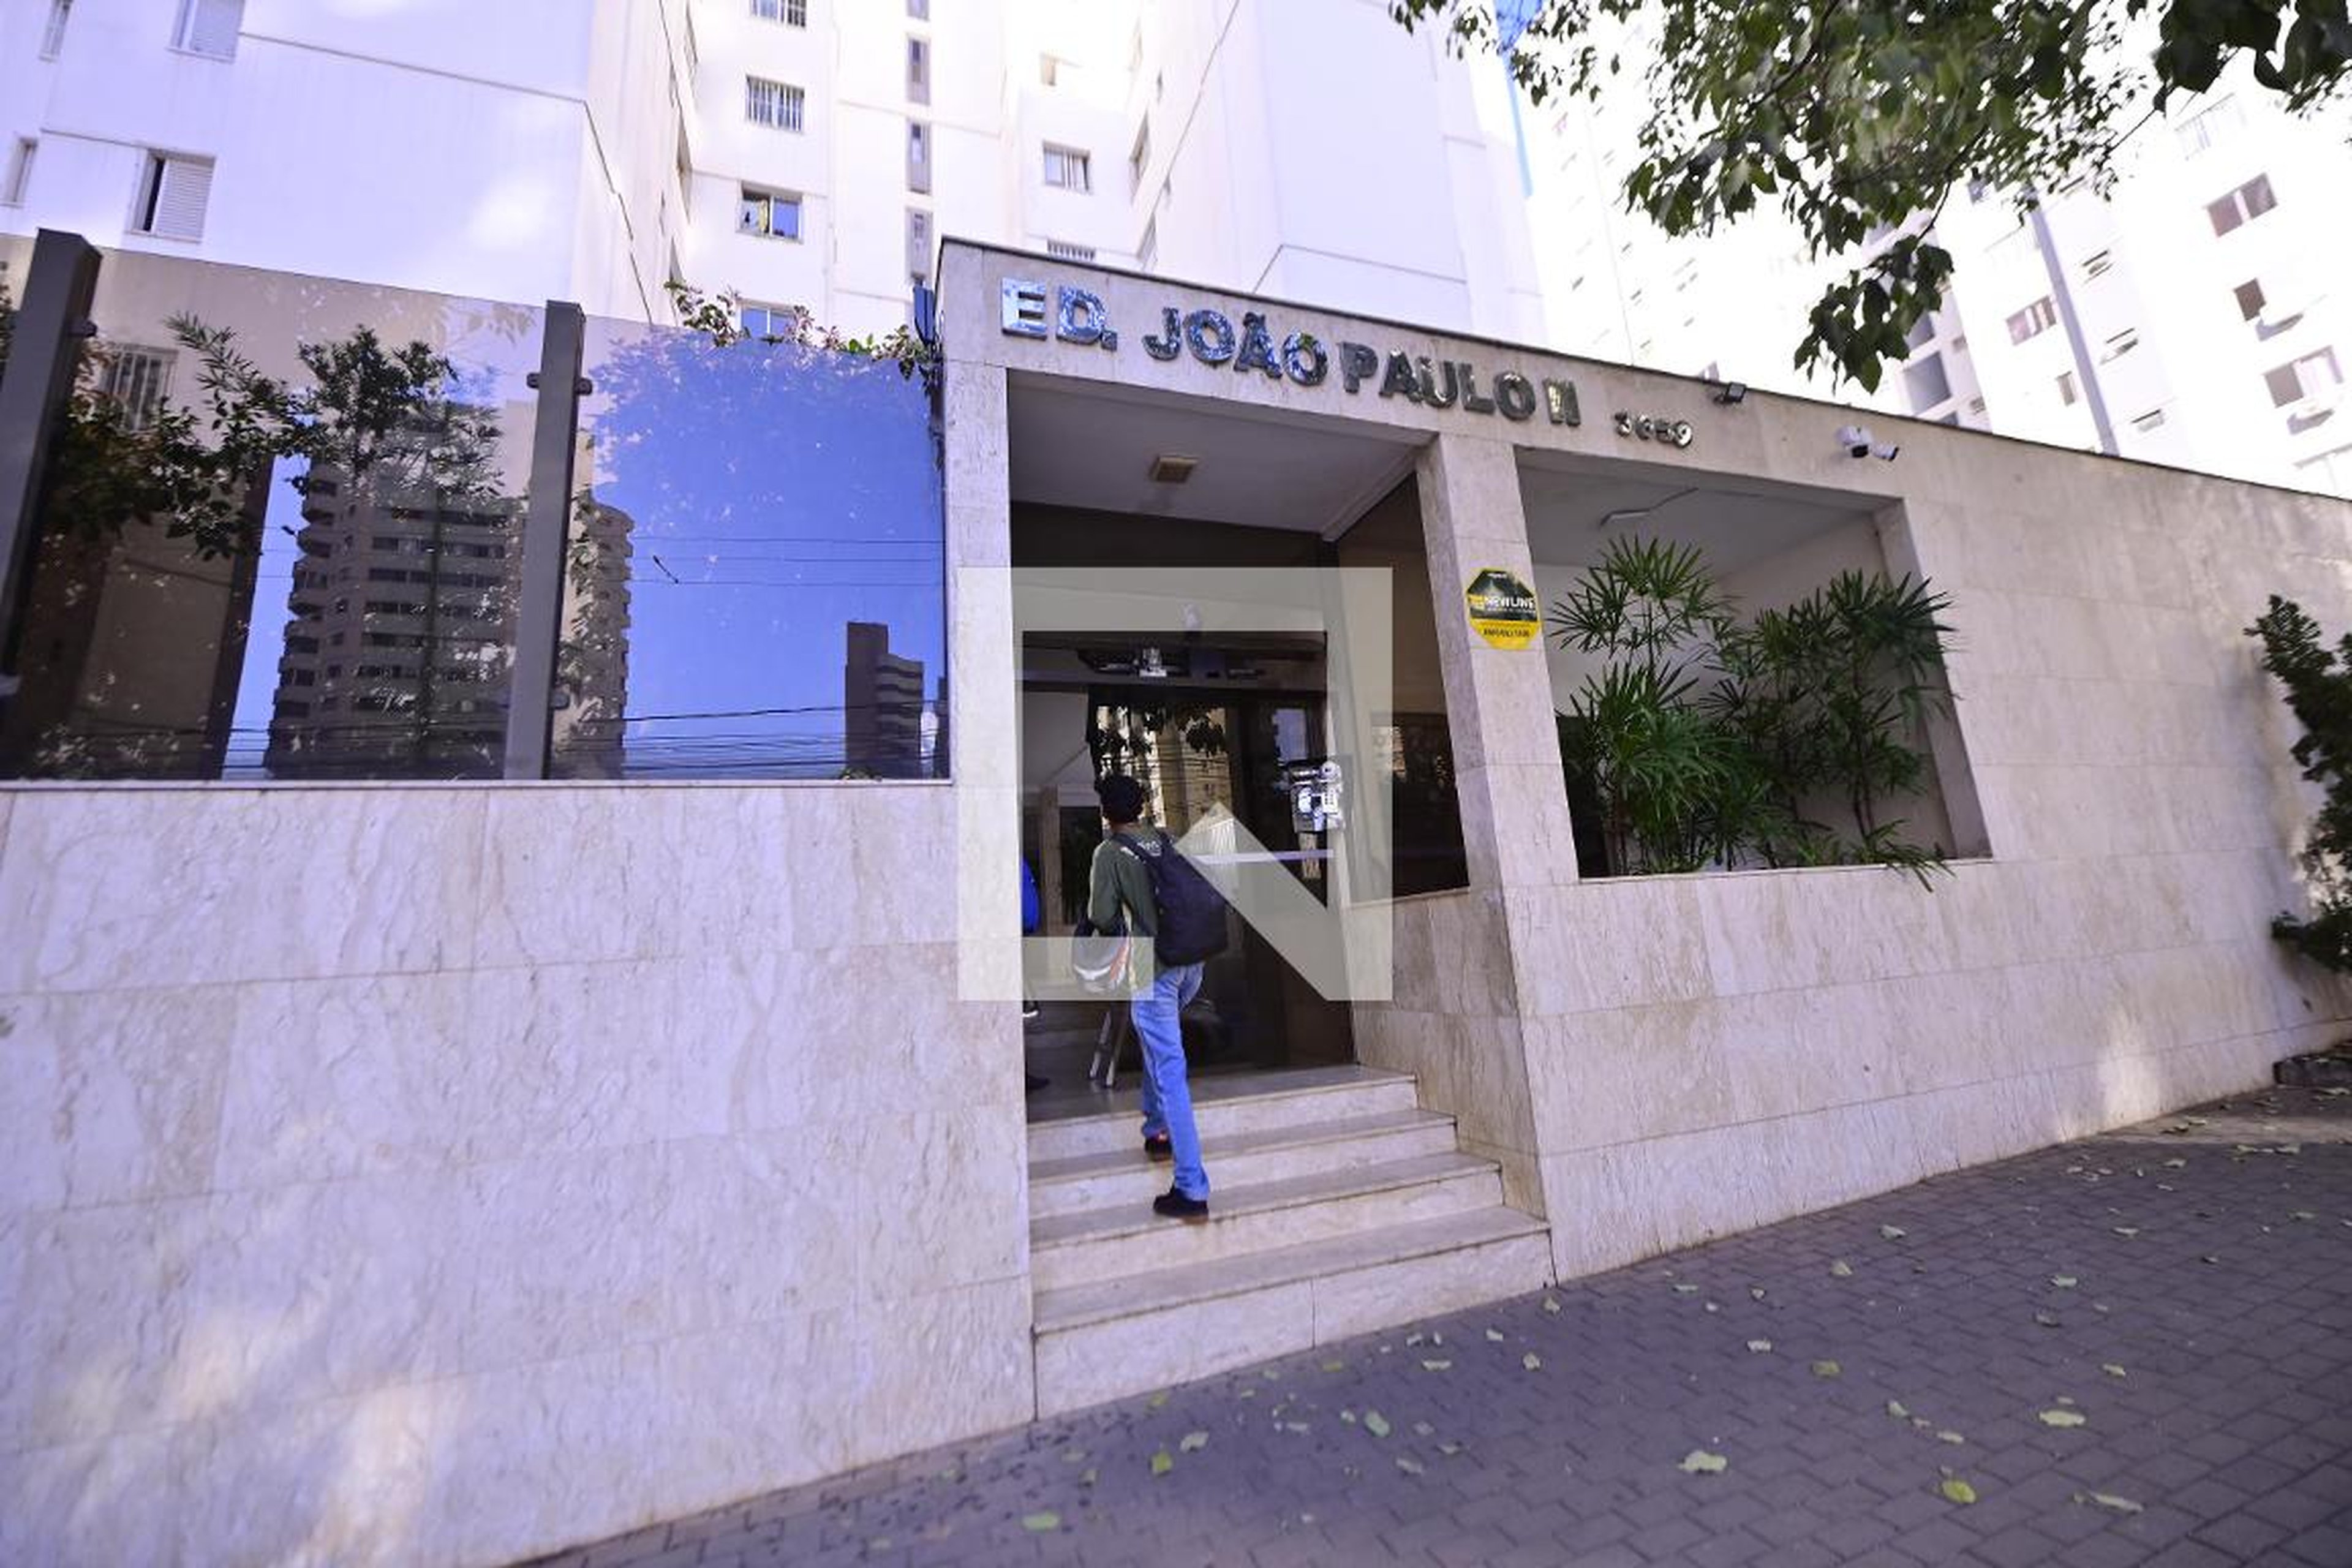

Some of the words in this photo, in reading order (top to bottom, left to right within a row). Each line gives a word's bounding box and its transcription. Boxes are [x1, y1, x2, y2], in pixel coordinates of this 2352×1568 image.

[1001, 277, 1118, 352] ED.
[1142, 307, 1329, 386] JOÃO
[1338, 341, 1536, 421] PAULO
[1542, 378, 1581, 427] II
